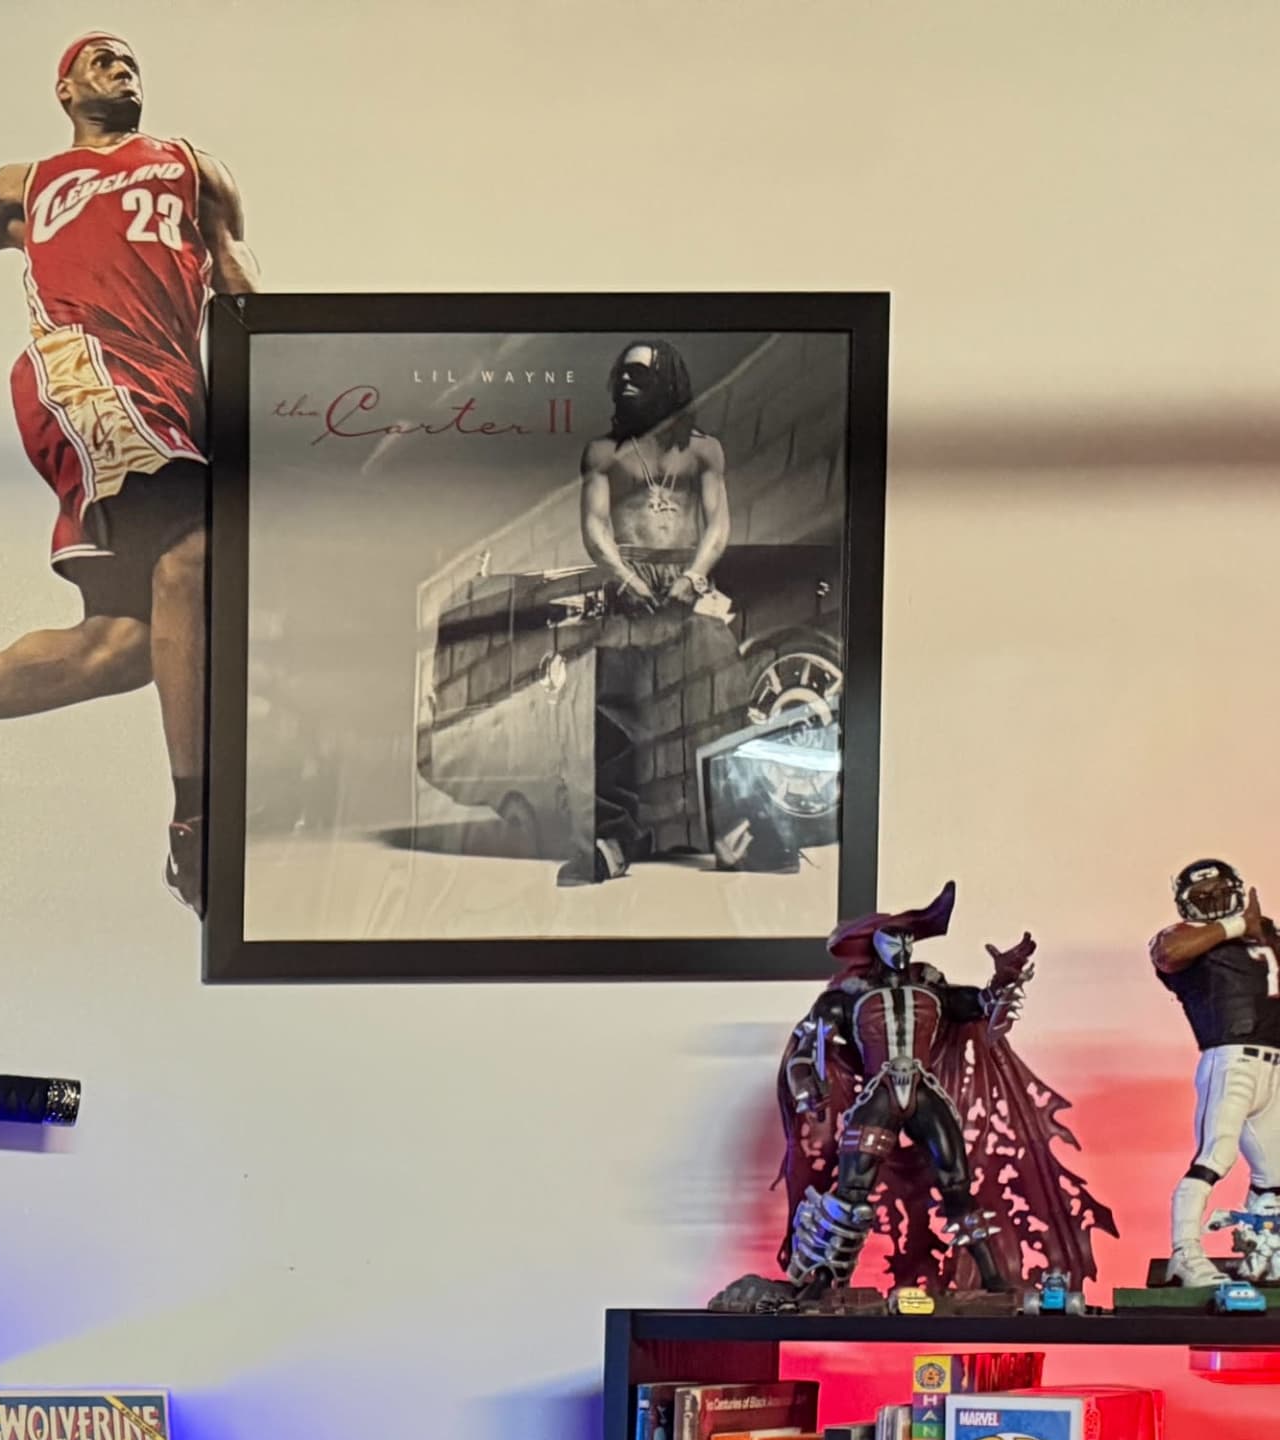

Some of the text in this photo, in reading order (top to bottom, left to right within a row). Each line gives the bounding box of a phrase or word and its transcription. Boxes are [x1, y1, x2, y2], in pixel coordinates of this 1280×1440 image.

[31, 162, 186, 243] CLEVELAND
[121, 188, 184, 251] 23
[414, 370, 576, 384] LIL WAYNE
[272, 385, 573, 446] the Carter II
[959, 1411, 999, 1426] MARVEL
